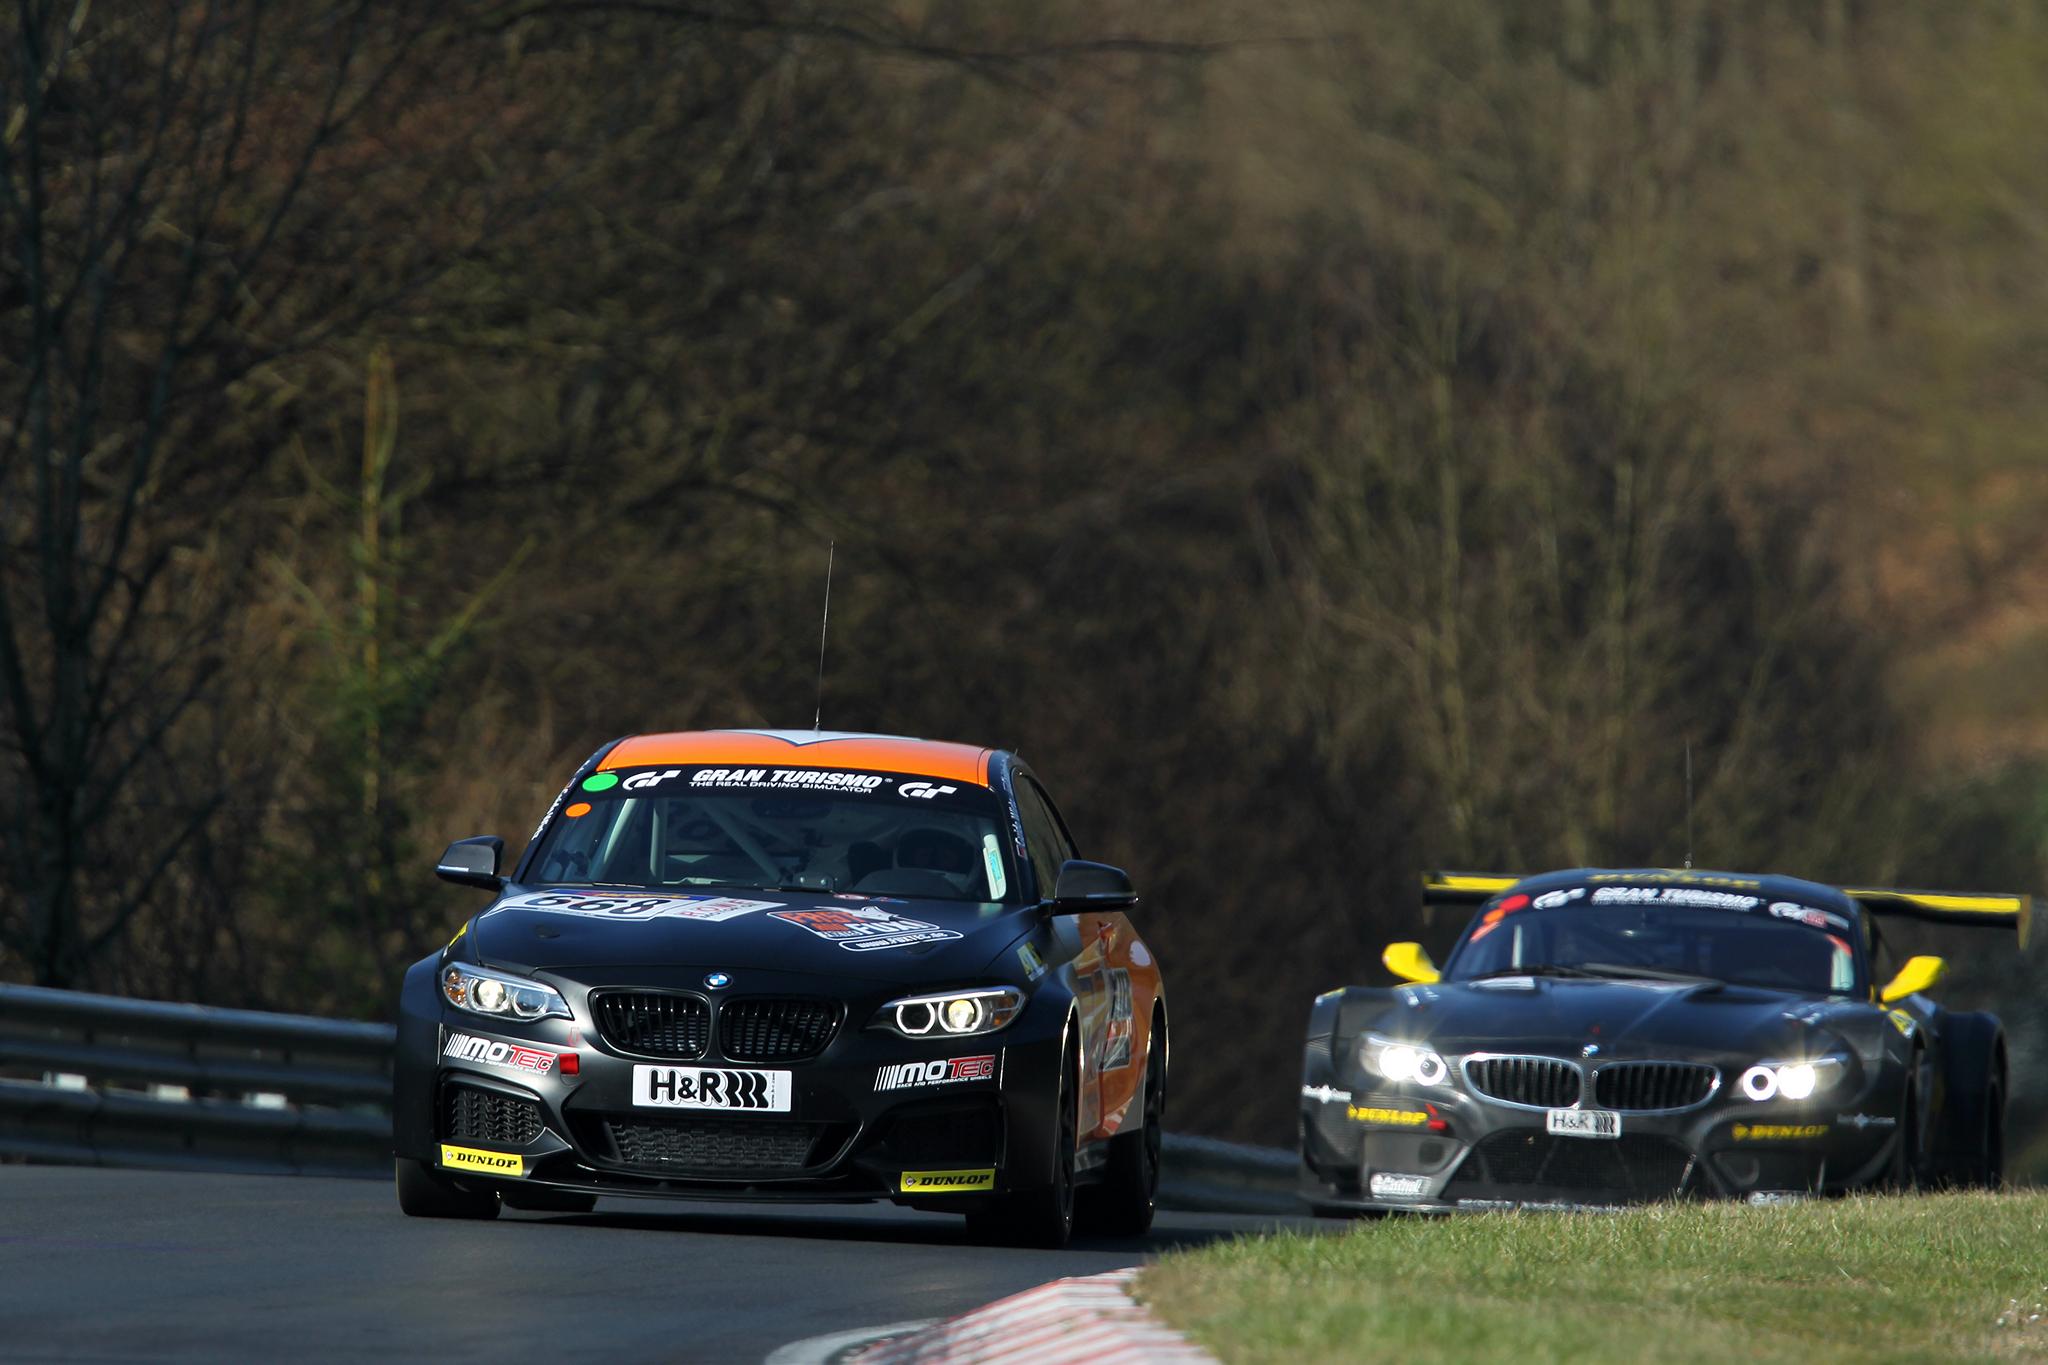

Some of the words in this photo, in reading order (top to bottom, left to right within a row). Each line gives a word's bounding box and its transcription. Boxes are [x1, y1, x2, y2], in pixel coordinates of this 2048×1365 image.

[691, 769, 767, 783] GRAN
[771, 769, 883, 789] TURISMO
[802, 783, 873, 794] SIMULATOR
[524, 895, 672, 915] 668
[1750, 1124, 1830, 1139] DUNLOP
[456, 1152, 518, 1168] DUNLOP
[919, 1174, 990, 1186] DUNLOP
